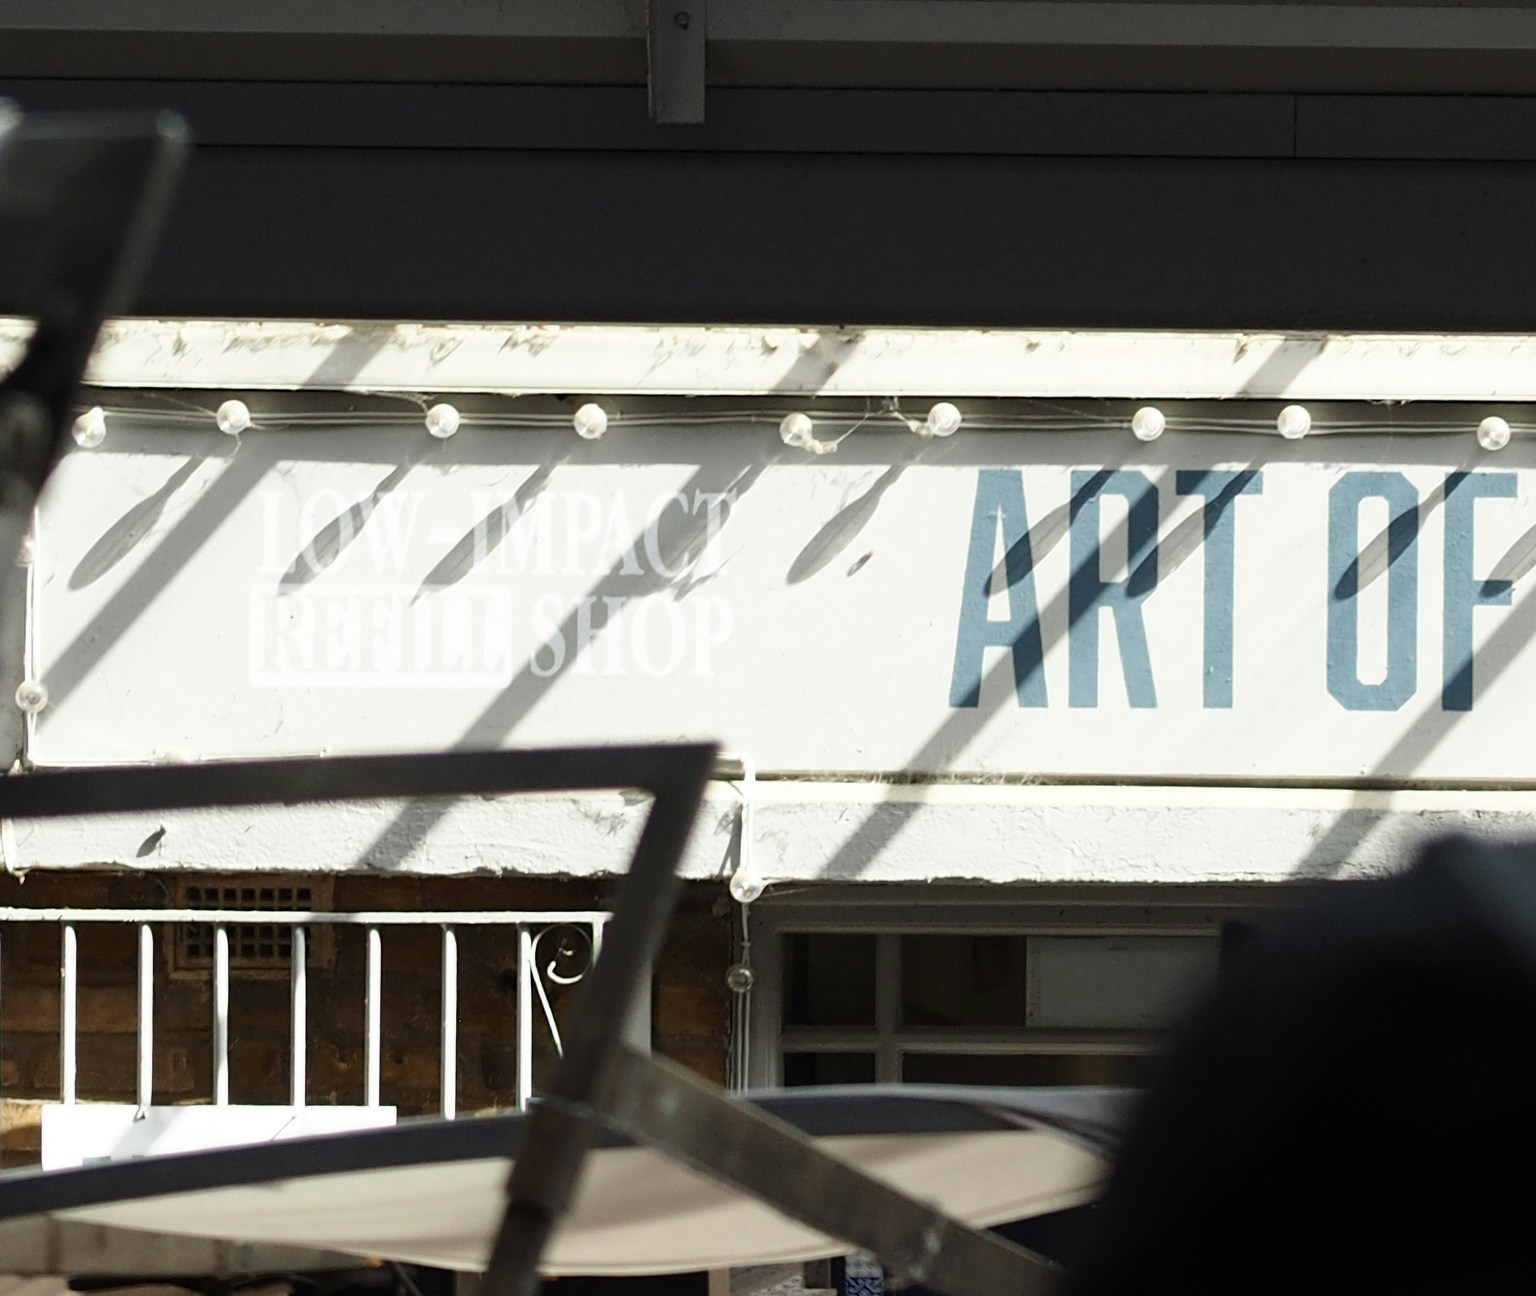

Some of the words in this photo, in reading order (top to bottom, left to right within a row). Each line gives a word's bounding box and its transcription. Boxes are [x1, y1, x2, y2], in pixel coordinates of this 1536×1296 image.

[257, 596, 505, 677] REFILL
[529, 594, 734, 679] SHOP
[947, 469, 1264, 709] ART
[1326, 470, 1519, 712] OF
